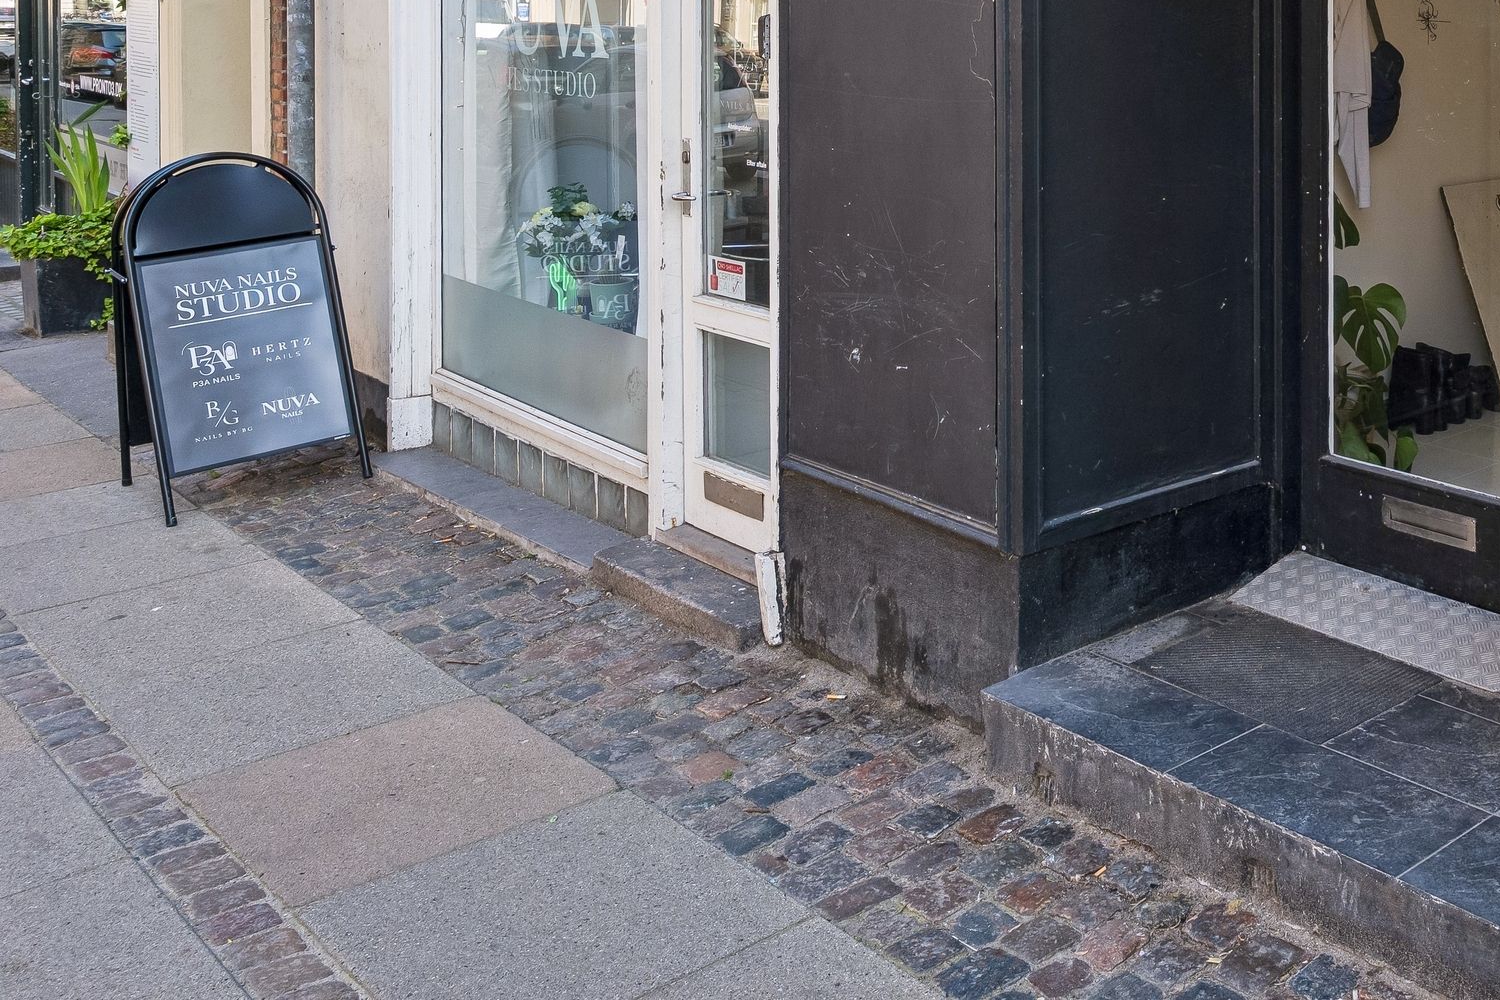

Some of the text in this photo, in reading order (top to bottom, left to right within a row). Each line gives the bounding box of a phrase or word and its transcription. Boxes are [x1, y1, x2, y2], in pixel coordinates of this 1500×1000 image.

[533, 69, 596, 99] STUDIO
[174, 267, 298, 298] NUVA NAILS
[176, 282, 301, 321] STUDIO
[252, 337, 312, 356] HERTZ
[266, 351, 302, 363] NAILS
[192, 373, 241, 388] P3A NAILS
[261, 392, 321, 416] NUVA
[281, 410, 304, 419] NAILS
[194, 433, 223, 443] NAILS
[227, 429, 238, 437] BY
